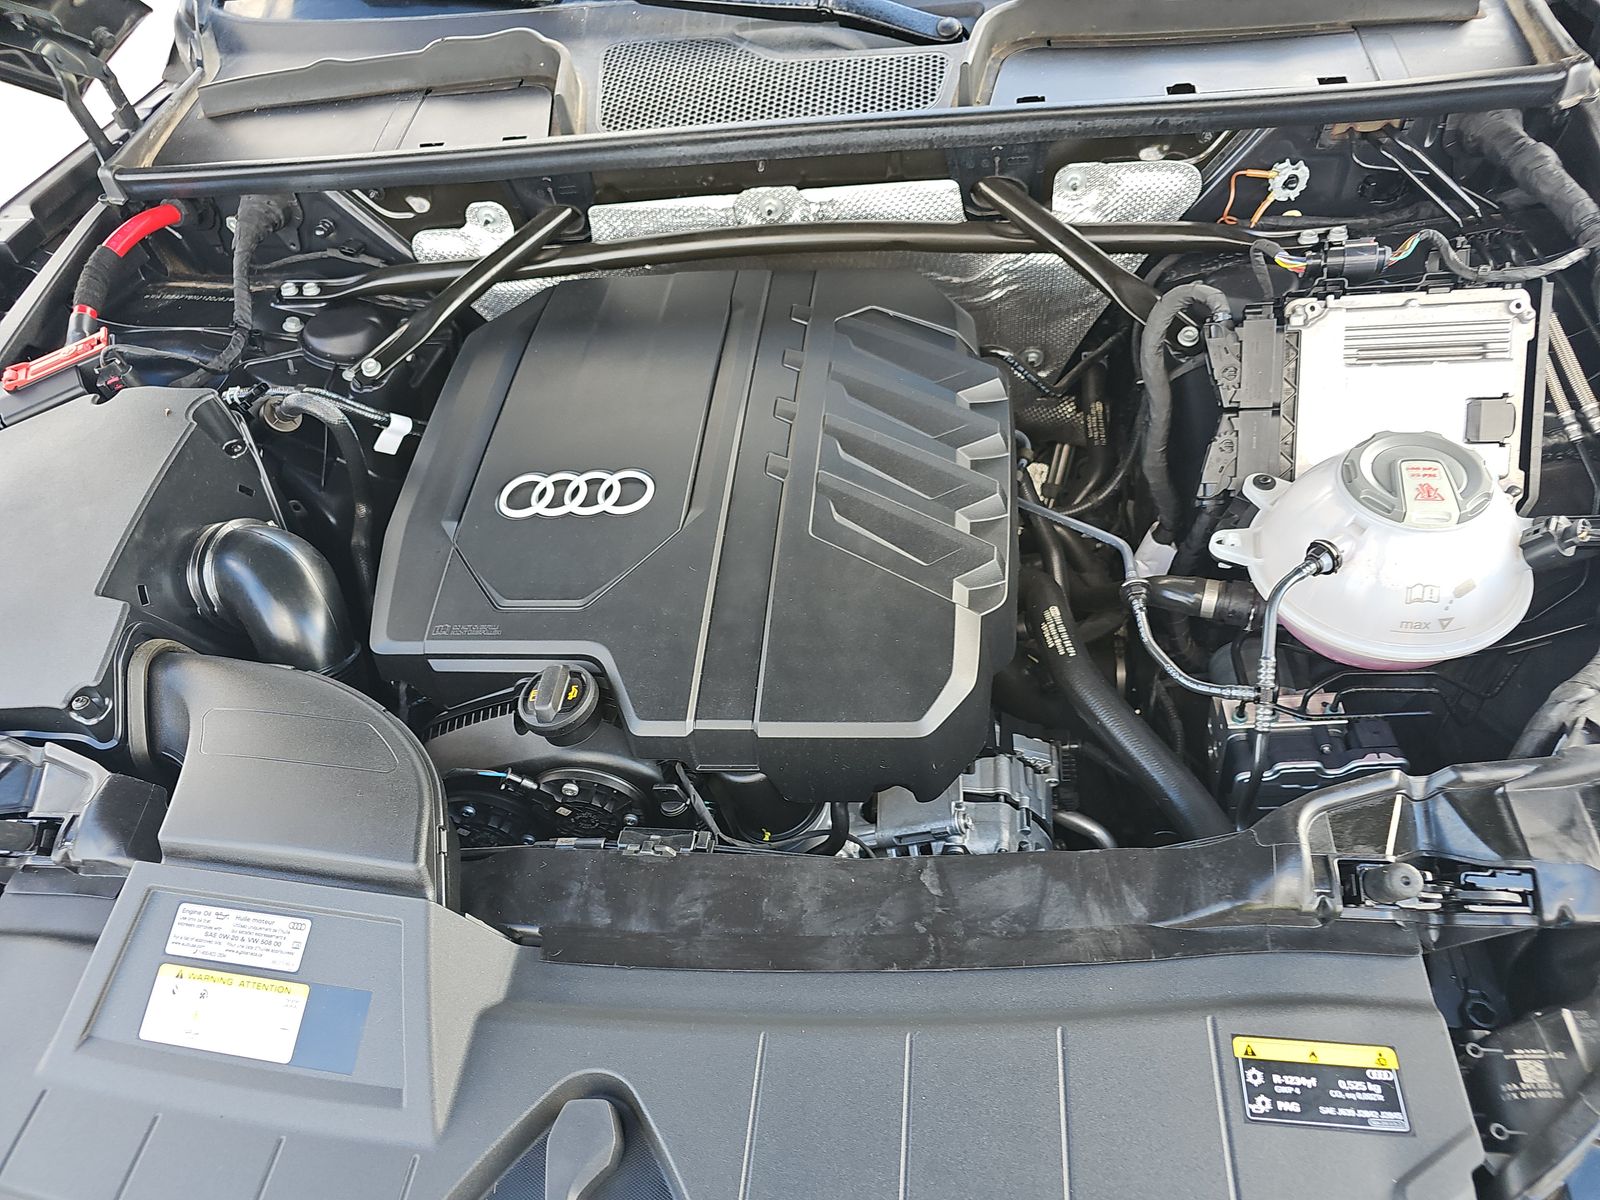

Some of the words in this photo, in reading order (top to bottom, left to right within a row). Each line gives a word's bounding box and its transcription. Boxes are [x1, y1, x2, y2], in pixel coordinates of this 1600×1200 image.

[1400, 621, 1431, 630] max
[181, 907, 202, 916] Engine
[218, 933, 239, 941] 0W-20
[188, 973, 233, 985] WARNING
[238, 980, 292, 994] ATTENTION
[1272, 1074, 1317, 1088] R-1234yf
[1367, 1081, 1382, 1093] kg
[1276, 1101, 1301, 1112] PAG
